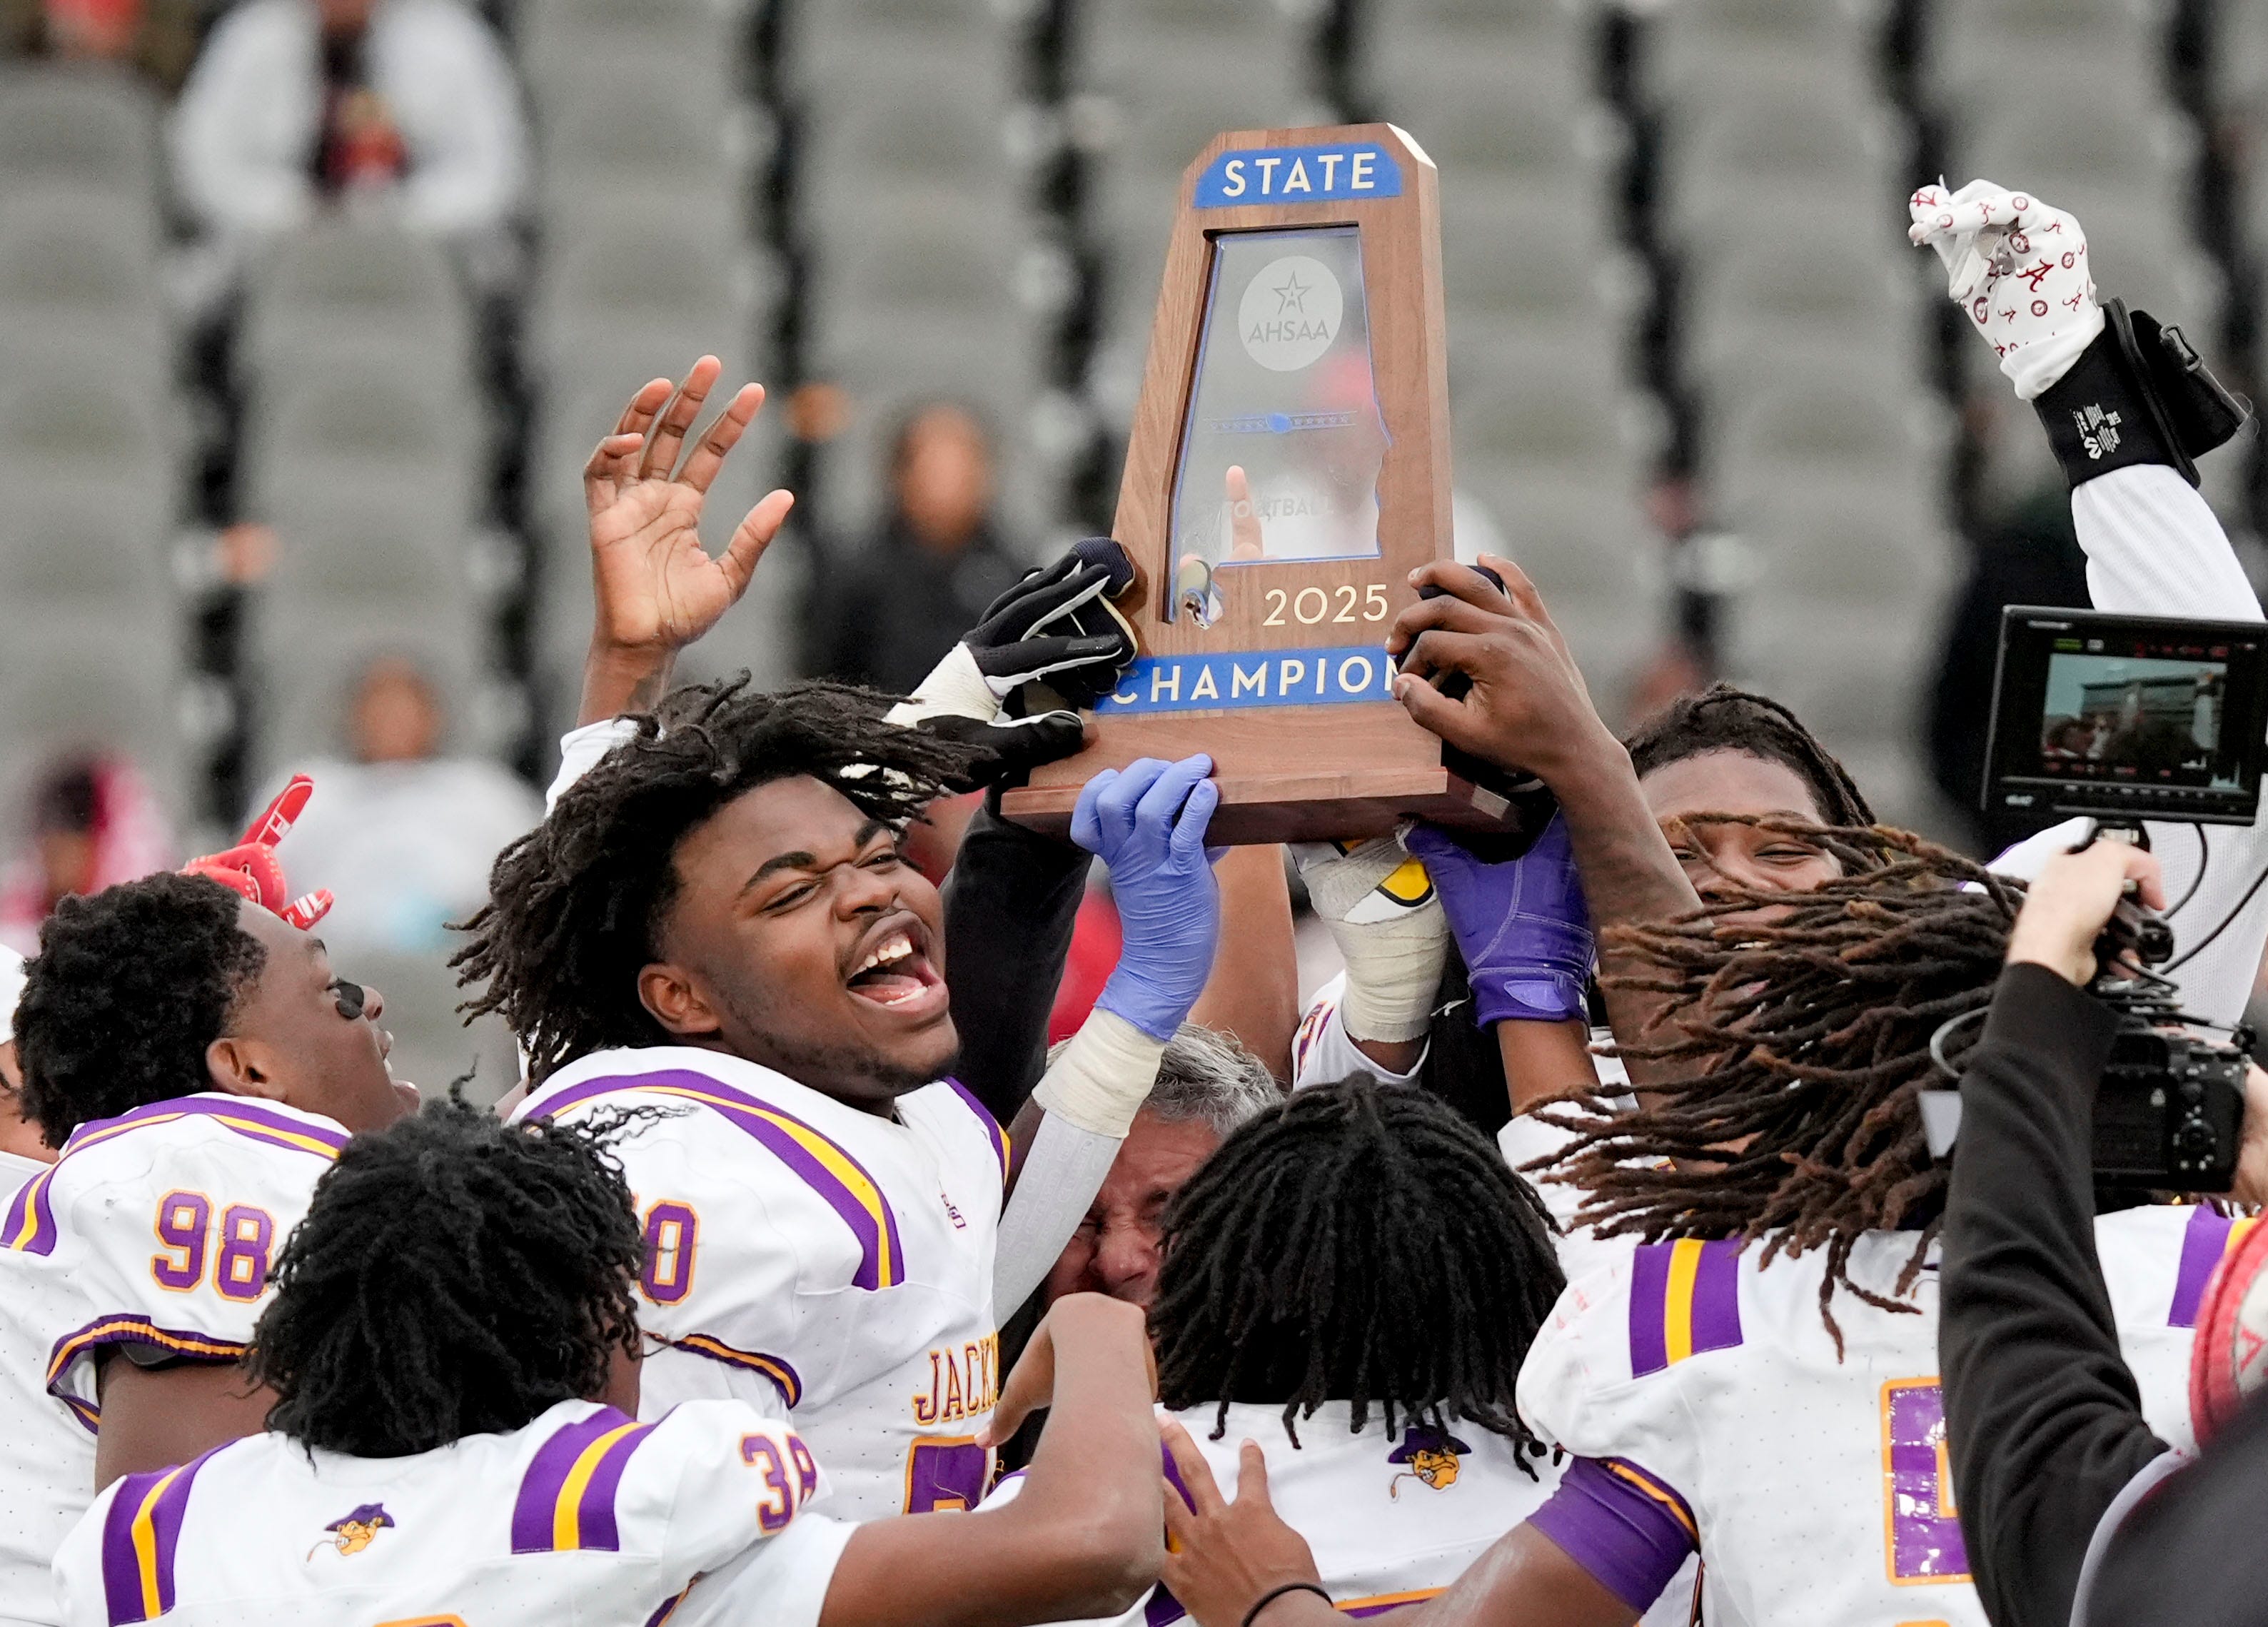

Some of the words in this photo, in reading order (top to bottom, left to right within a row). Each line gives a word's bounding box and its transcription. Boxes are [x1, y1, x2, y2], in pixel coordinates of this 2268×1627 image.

[1221, 151, 1377, 197] STATE
[1247, 319, 1330, 344] AHSAA
[1261, 583, 1388, 627] 2025
[150, 1187, 277, 1304] 98
[630, 1191, 700, 1306] 0
